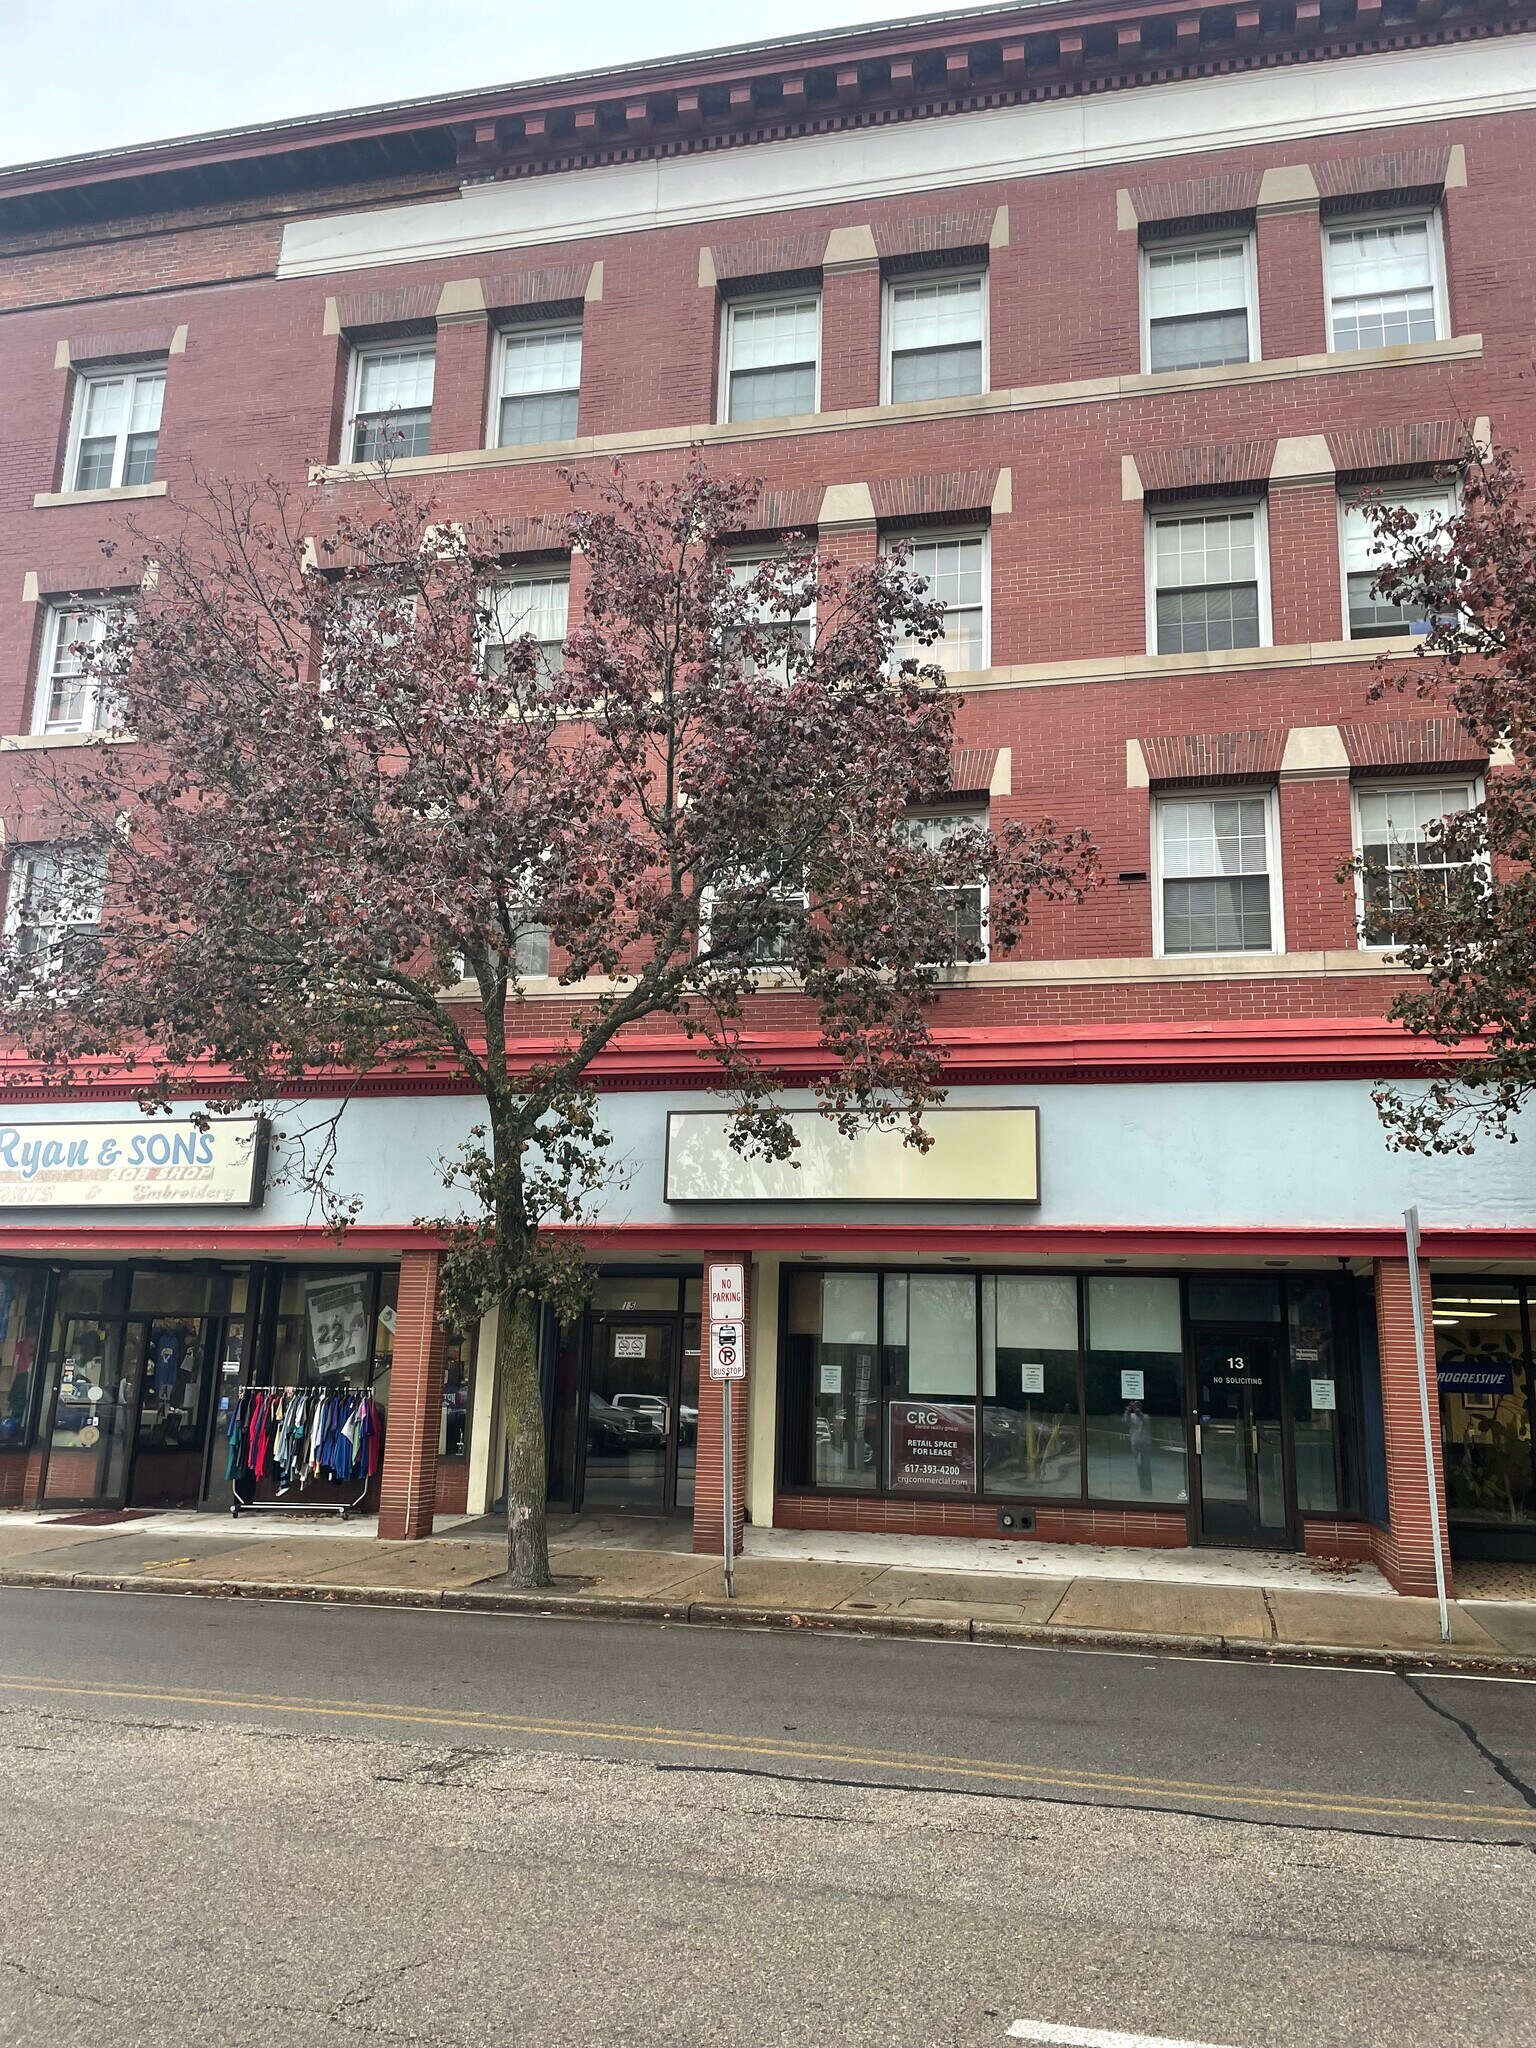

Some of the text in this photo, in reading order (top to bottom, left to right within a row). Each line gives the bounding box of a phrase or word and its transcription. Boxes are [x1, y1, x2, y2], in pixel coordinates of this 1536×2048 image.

[0, 1128, 216, 1178] Ryan & SONS
[154, 1166, 213, 1180] SHOP
[132, 1184, 236, 1202] Embroidery
[721, 1279, 732, 1289] NO
[712, 1292, 742, 1302] PARKING
[1227, 1357, 1245, 1370] 13
[713, 1366, 742, 1376] BUS STOP
[1225, 1377, 1263, 1385] SOLICITING
[1437, 1372, 1506, 1384] ROGRESSIVE
[906, 1411, 939, 1425] CRG
[907, 1439, 958, 1449] RETAIL SPACE
[912, 1447, 953, 1457] FOR LEASE
[904, 1463, 960, 1476] 617-393-4200
[897, 1476, 968, 1487] crgcommercial.com
